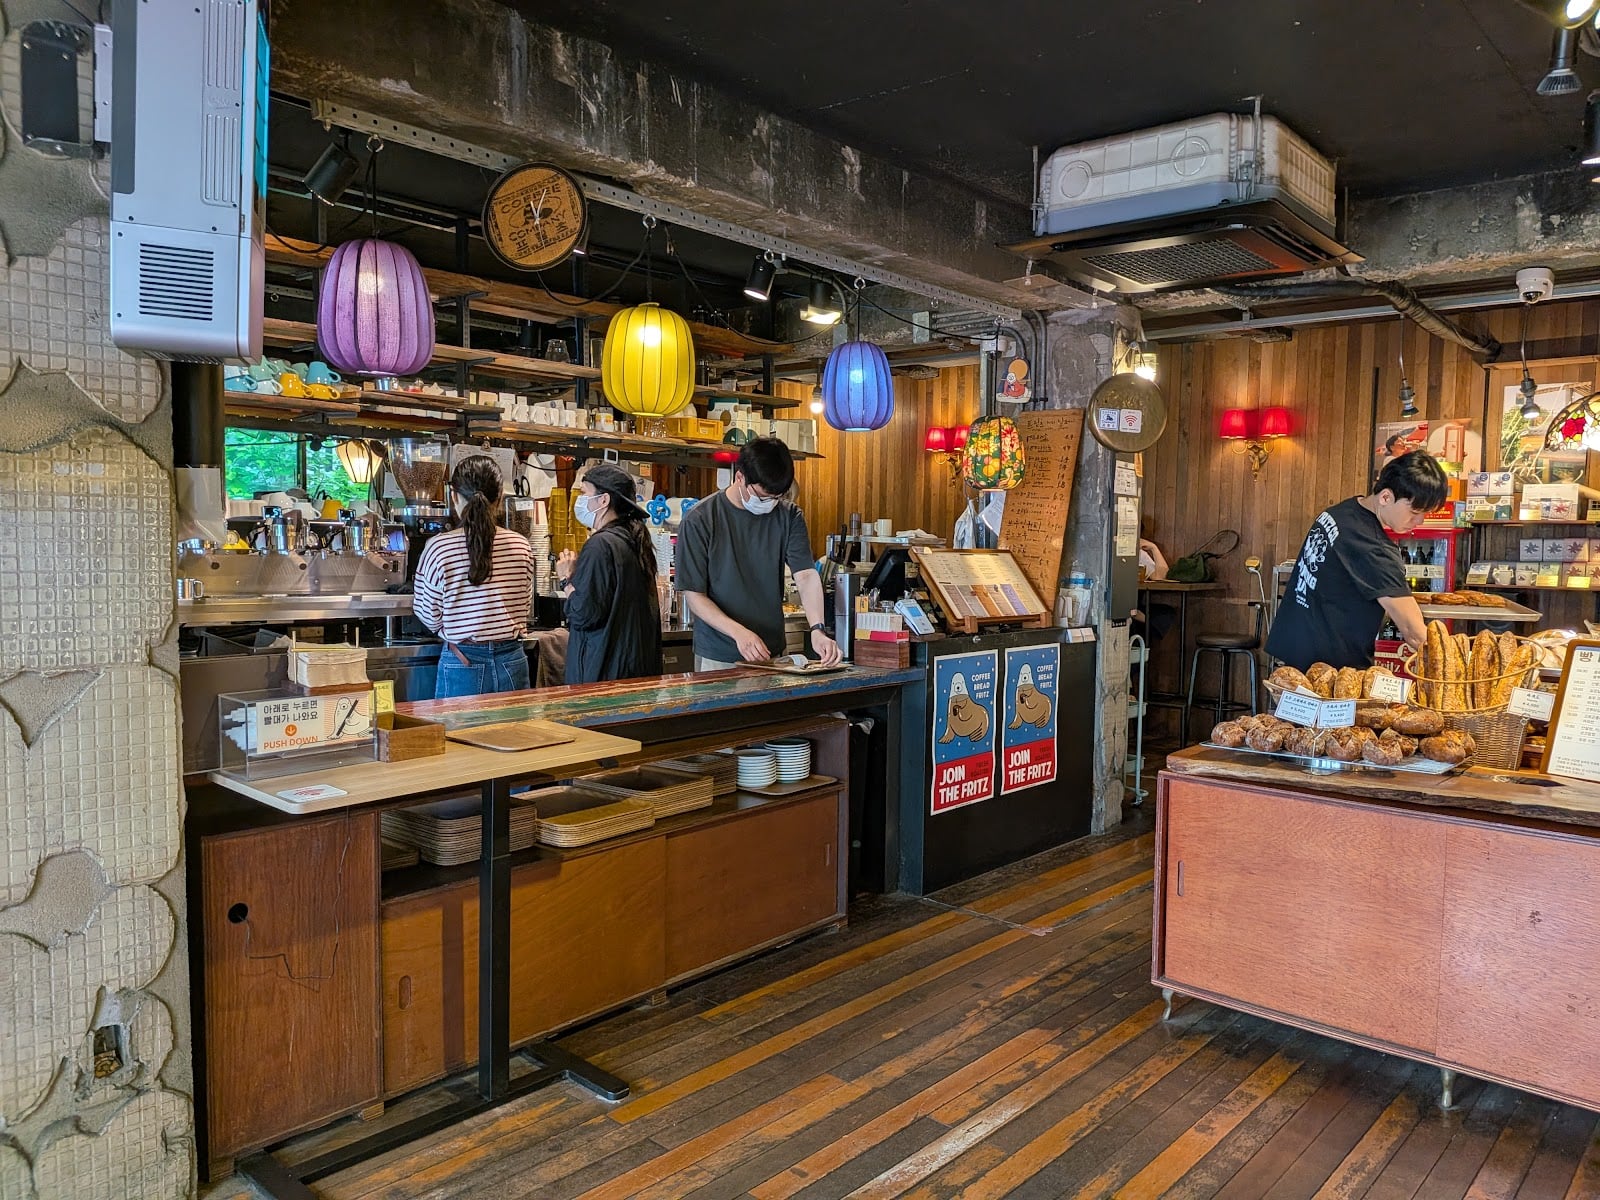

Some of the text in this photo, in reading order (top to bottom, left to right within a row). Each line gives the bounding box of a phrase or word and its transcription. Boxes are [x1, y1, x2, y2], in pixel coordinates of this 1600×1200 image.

[501, 183, 561, 214] COFFEE
[1579, 652, 1594, 662] 빵
[1036, 665, 1054, 673] COFFEE
[971, 673, 991, 682] COFFEE
[1038, 673, 1053, 681] BREAD
[973, 682, 991, 691] BREAD
[1039, 681, 1052, 689] FRITZ
[975, 691, 990, 700] FRITZ
[263, 700, 318, 714] 아래로 누르면
[263, 711, 318, 725] 빨대가 나와요
[263, 736, 318, 749] PUSH DOWN
[1008, 749, 1031, 768] JOIN
[938, 765, 966, 786] JOIN
[1008, 761, 1052, 786] THE FRITZ
[938, 777, 989, 804] THE FRITZ
